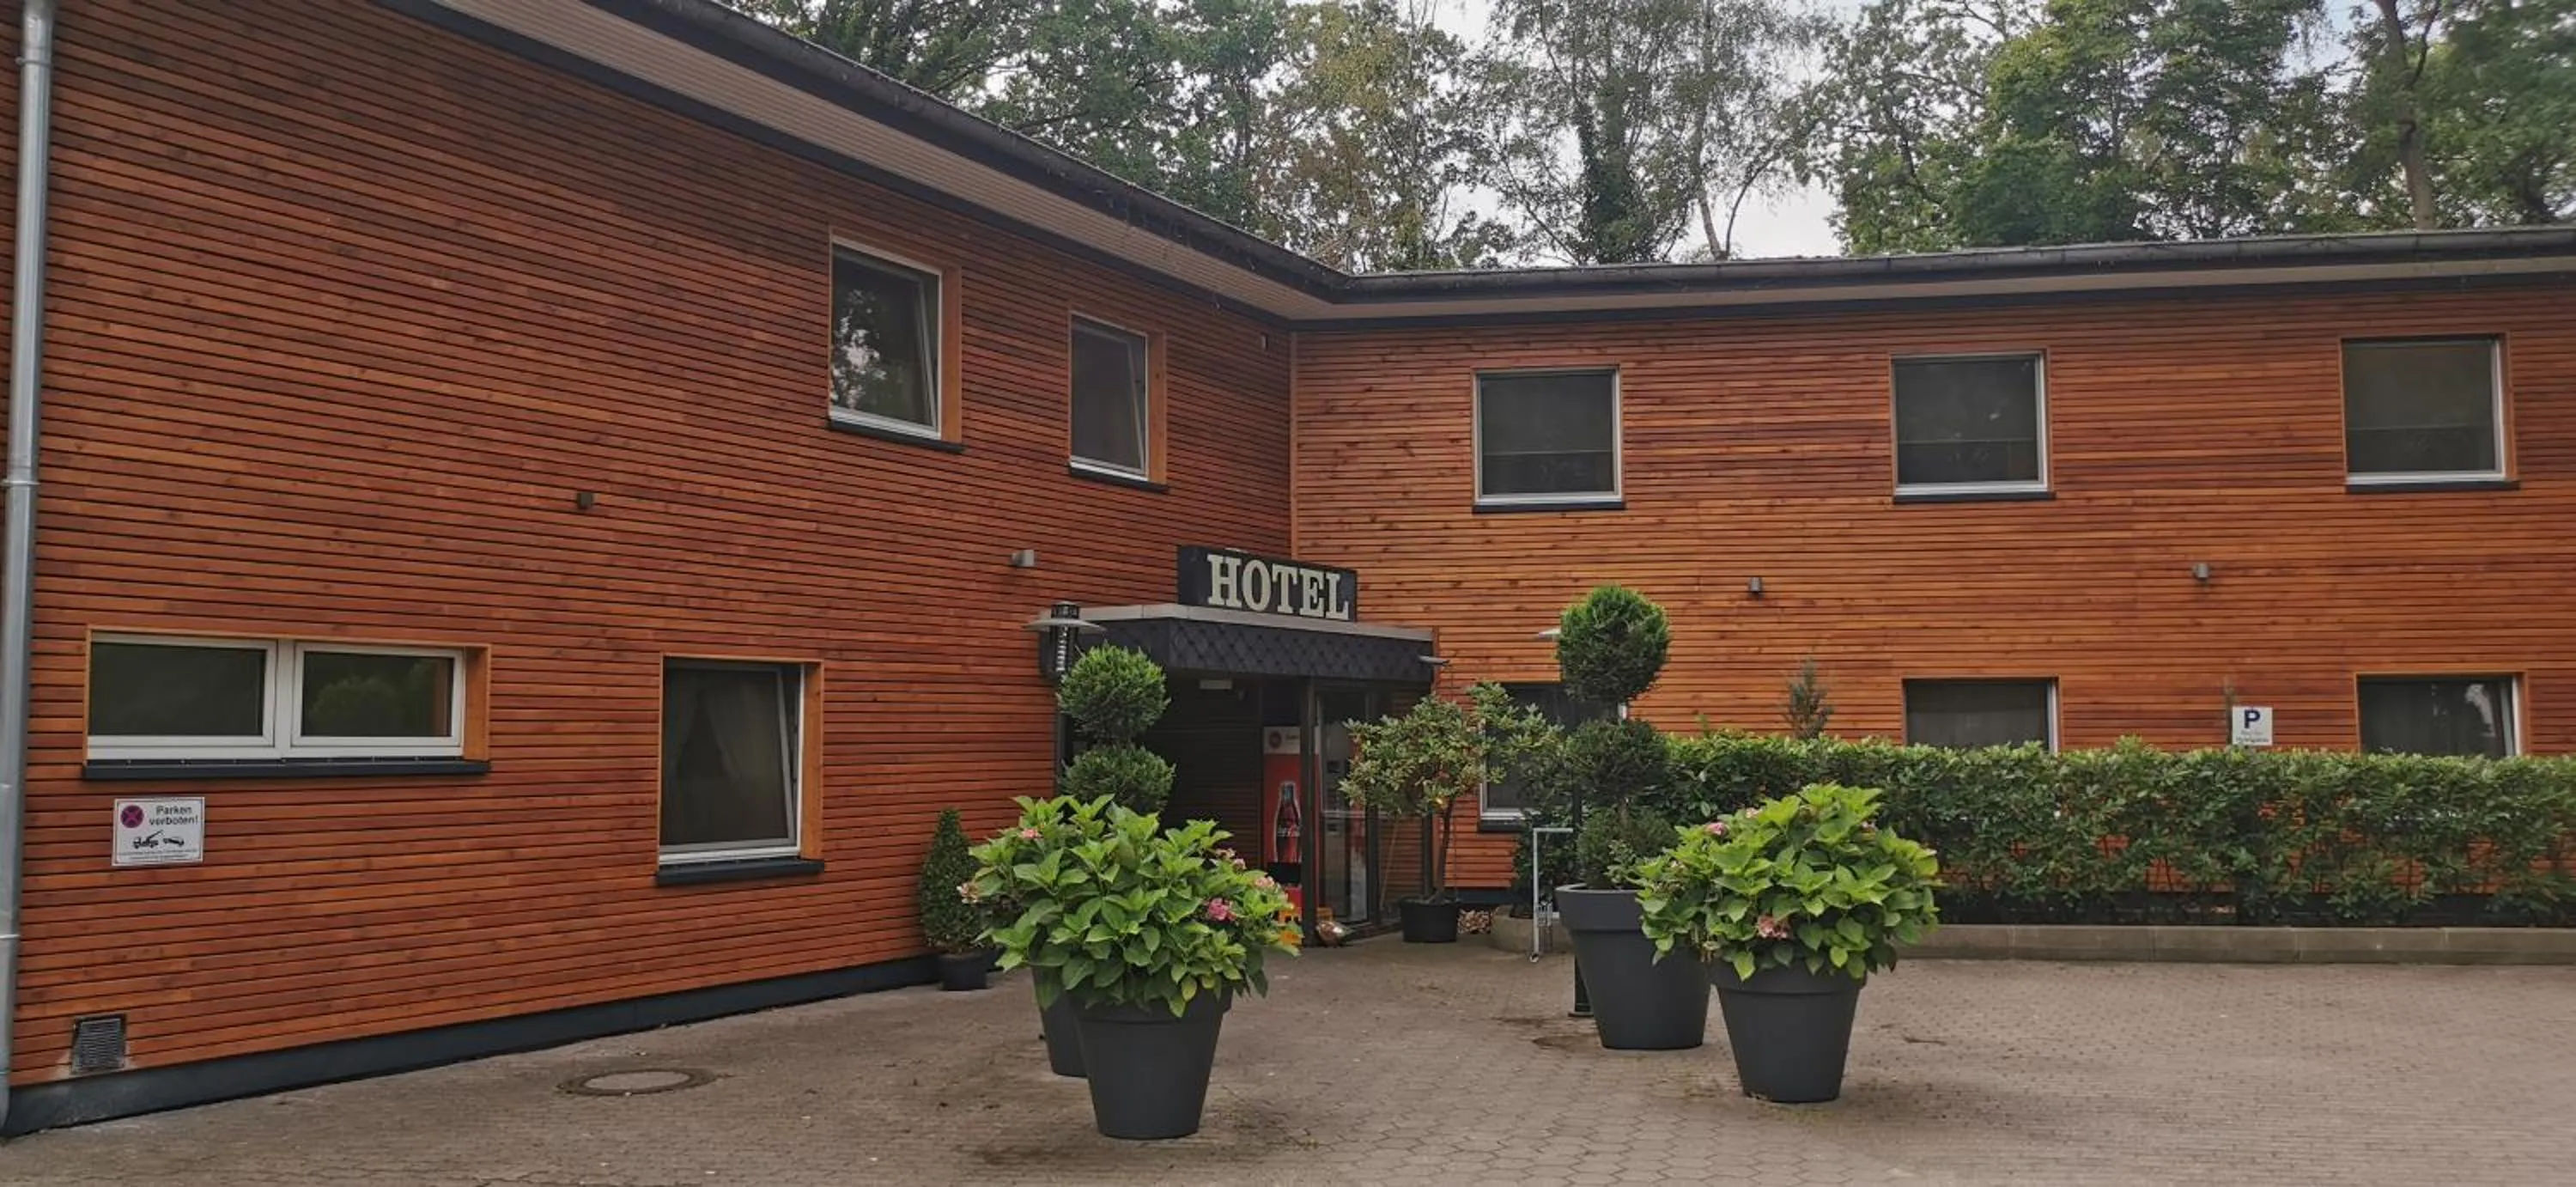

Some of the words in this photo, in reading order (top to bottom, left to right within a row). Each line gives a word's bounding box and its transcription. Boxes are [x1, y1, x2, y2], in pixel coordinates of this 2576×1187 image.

[1207, 553, 1350, 620] HOTEL
[2244, 709, 2261, 729] P
[155, 805, 192, 815] Parken
[149, 815, 198, 825] verboten!
